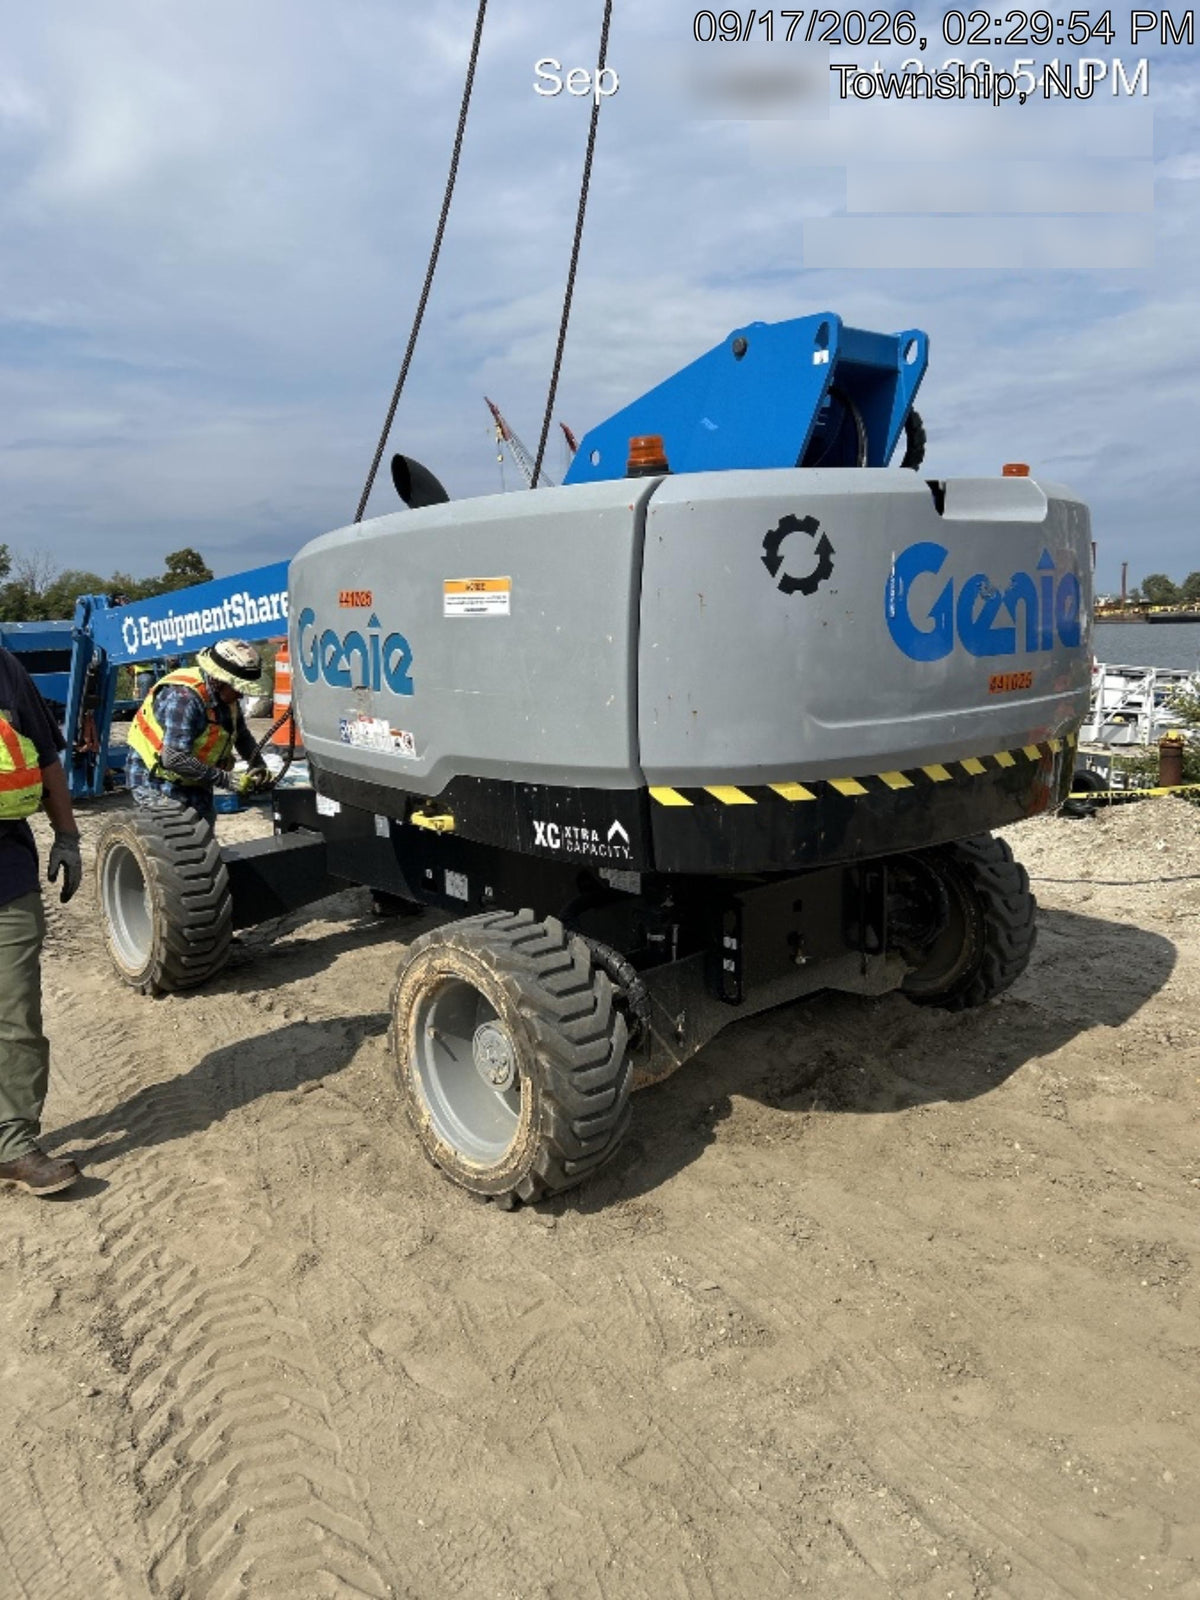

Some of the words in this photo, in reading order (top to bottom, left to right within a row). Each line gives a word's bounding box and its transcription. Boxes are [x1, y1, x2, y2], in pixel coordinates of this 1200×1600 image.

[885, 541, 1081, 662] Genie
[298, 607, 415, 697] Genie
[532, 820, 561, 849] XC
[565, 826, 600, 842] XTRA
[567, 841, 631, 859] CAPACITY
